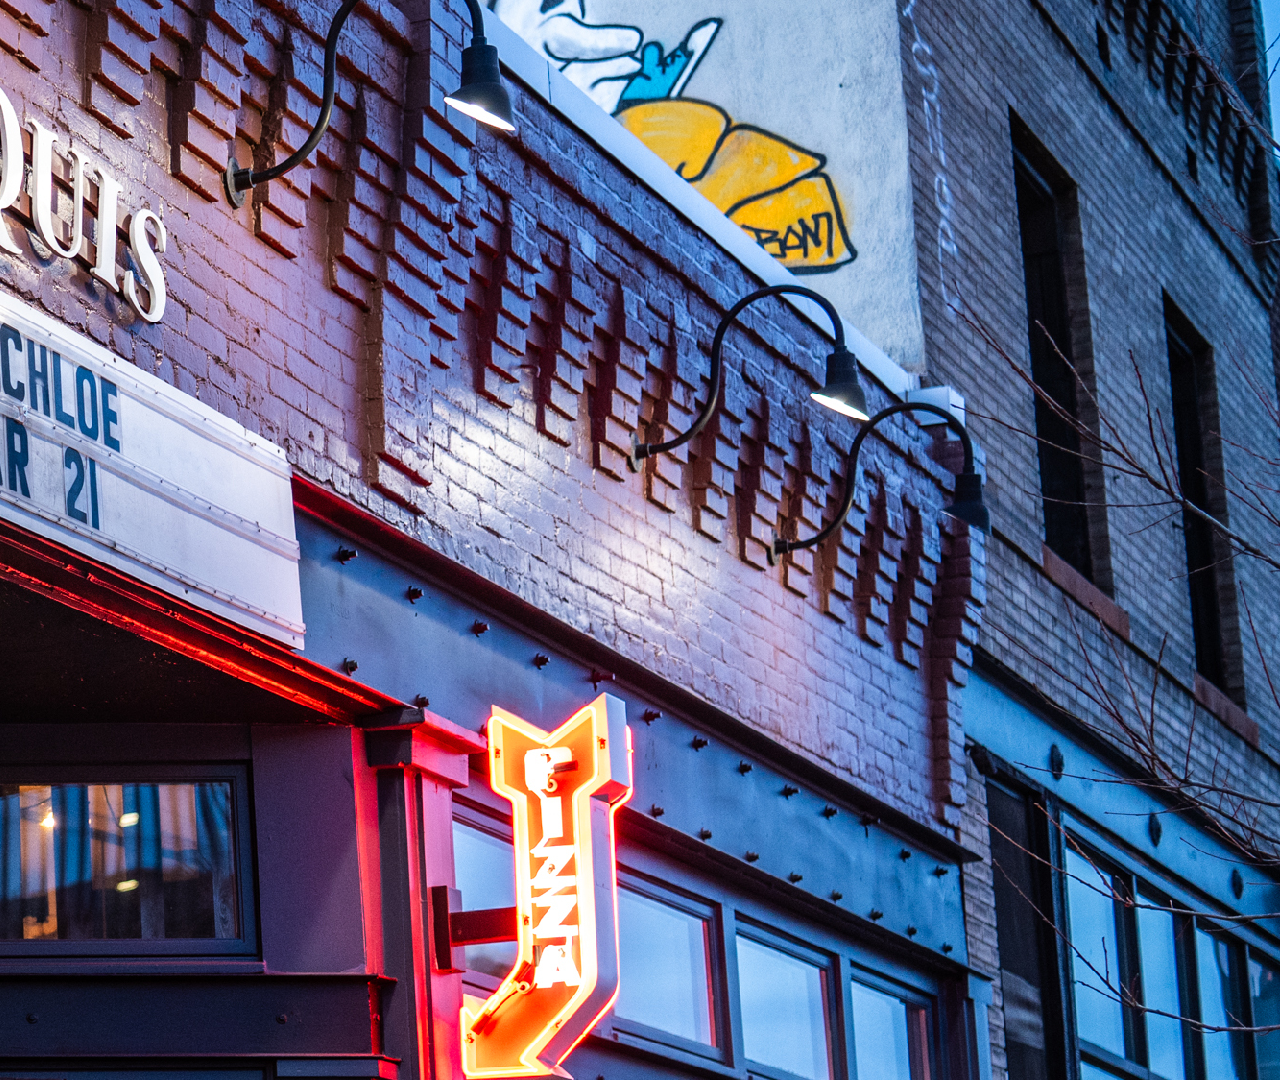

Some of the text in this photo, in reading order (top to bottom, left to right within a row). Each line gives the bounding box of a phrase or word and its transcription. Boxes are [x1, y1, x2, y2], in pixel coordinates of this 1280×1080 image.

[0, 323, 122, 452] CHLOE
[64, 447, 99, 530] 21
[524, 747, 582, 989] PIZZA
